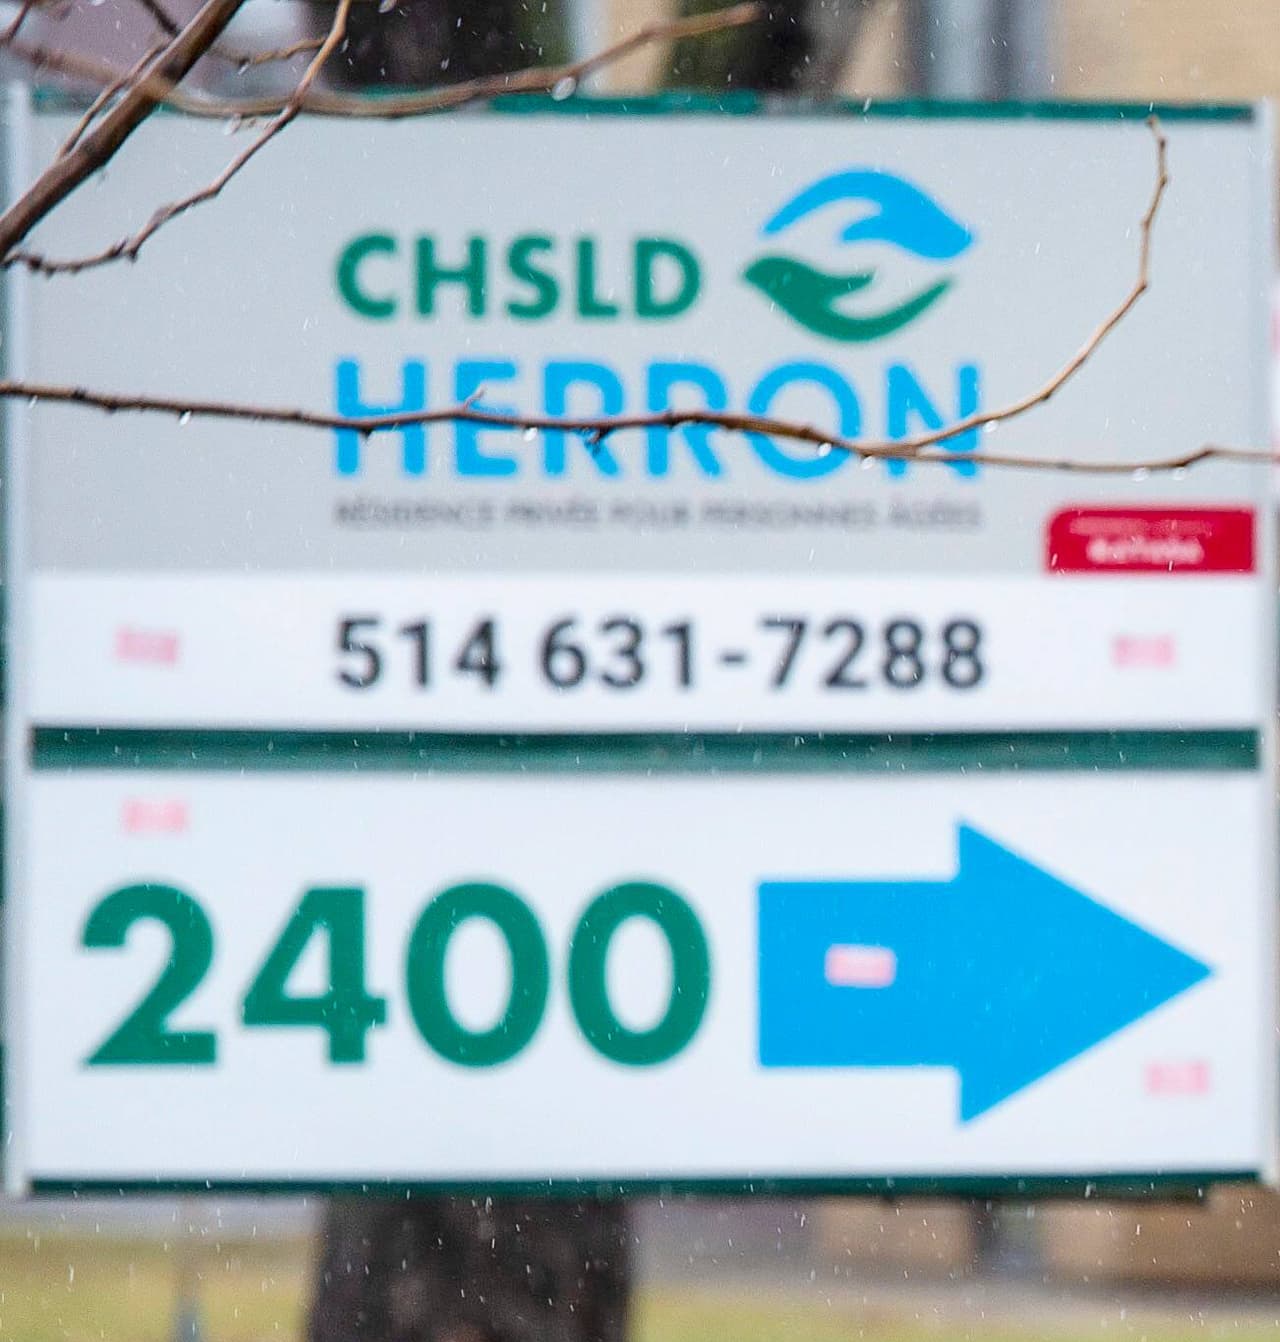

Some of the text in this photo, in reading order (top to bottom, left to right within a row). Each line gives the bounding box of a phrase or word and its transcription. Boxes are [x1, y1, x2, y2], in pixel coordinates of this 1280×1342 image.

[333, 231, 703, 321] CHSLD
[331, 356, 984, 482] HERRON
[337, 616, 986, 692] 514 631-7288
[79, 881, 713, 1068] 2400
